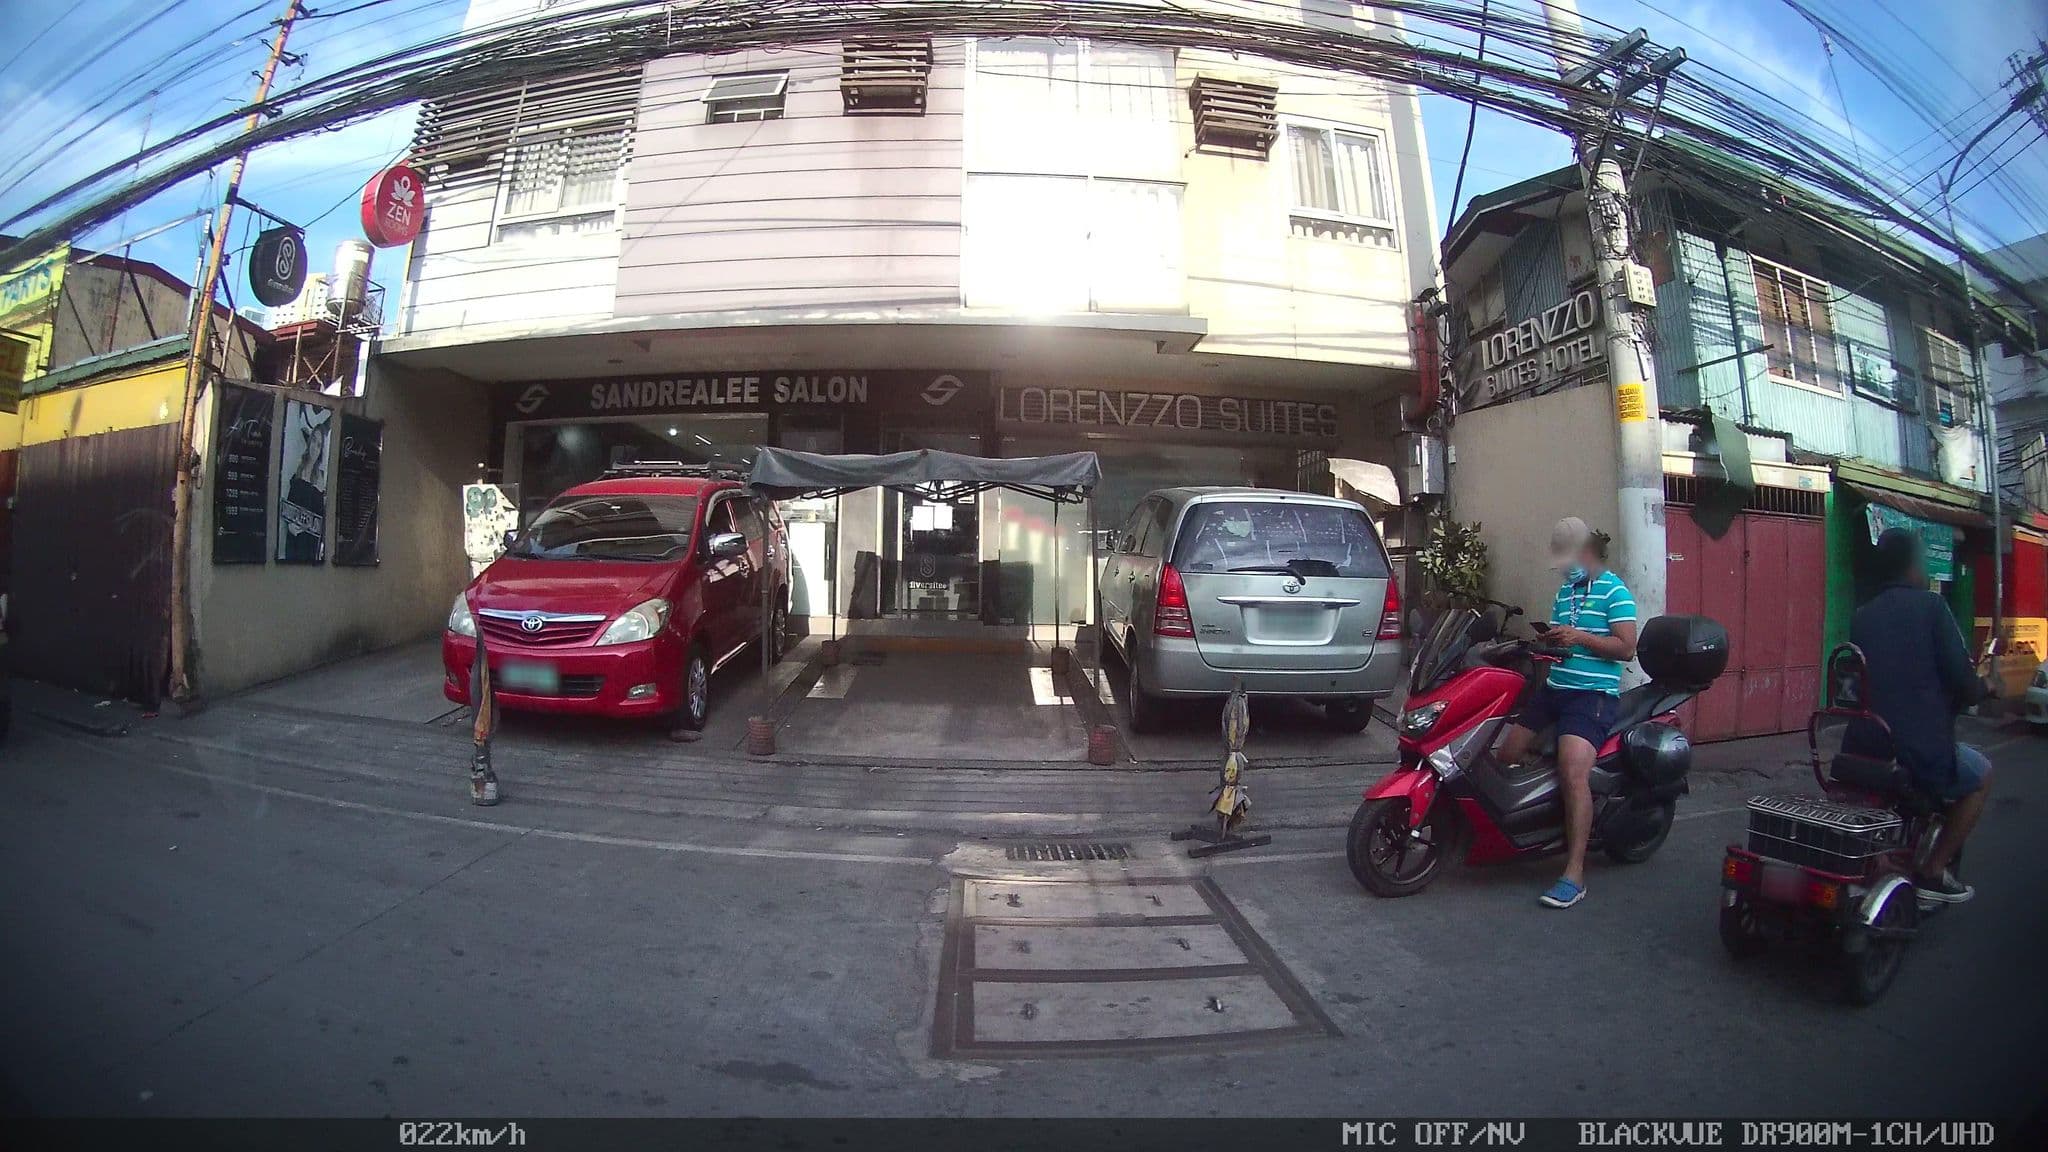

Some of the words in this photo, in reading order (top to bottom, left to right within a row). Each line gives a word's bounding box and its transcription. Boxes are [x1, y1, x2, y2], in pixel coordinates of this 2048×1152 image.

[387, 201, 411, 226] ZEN
[1481, 290, 1596, 371] LORENZZO
[1486, 358, 1540, 397] SUITES
[1543, 334, 1603, 374] HOTEL
[590, 376, 761, 410] SANDREALEE
[773, 376, 868, 404] SALON
[1000, 387, 1202, 429] LORENZZO
[1218, 397, 1338, 437] SUITES
